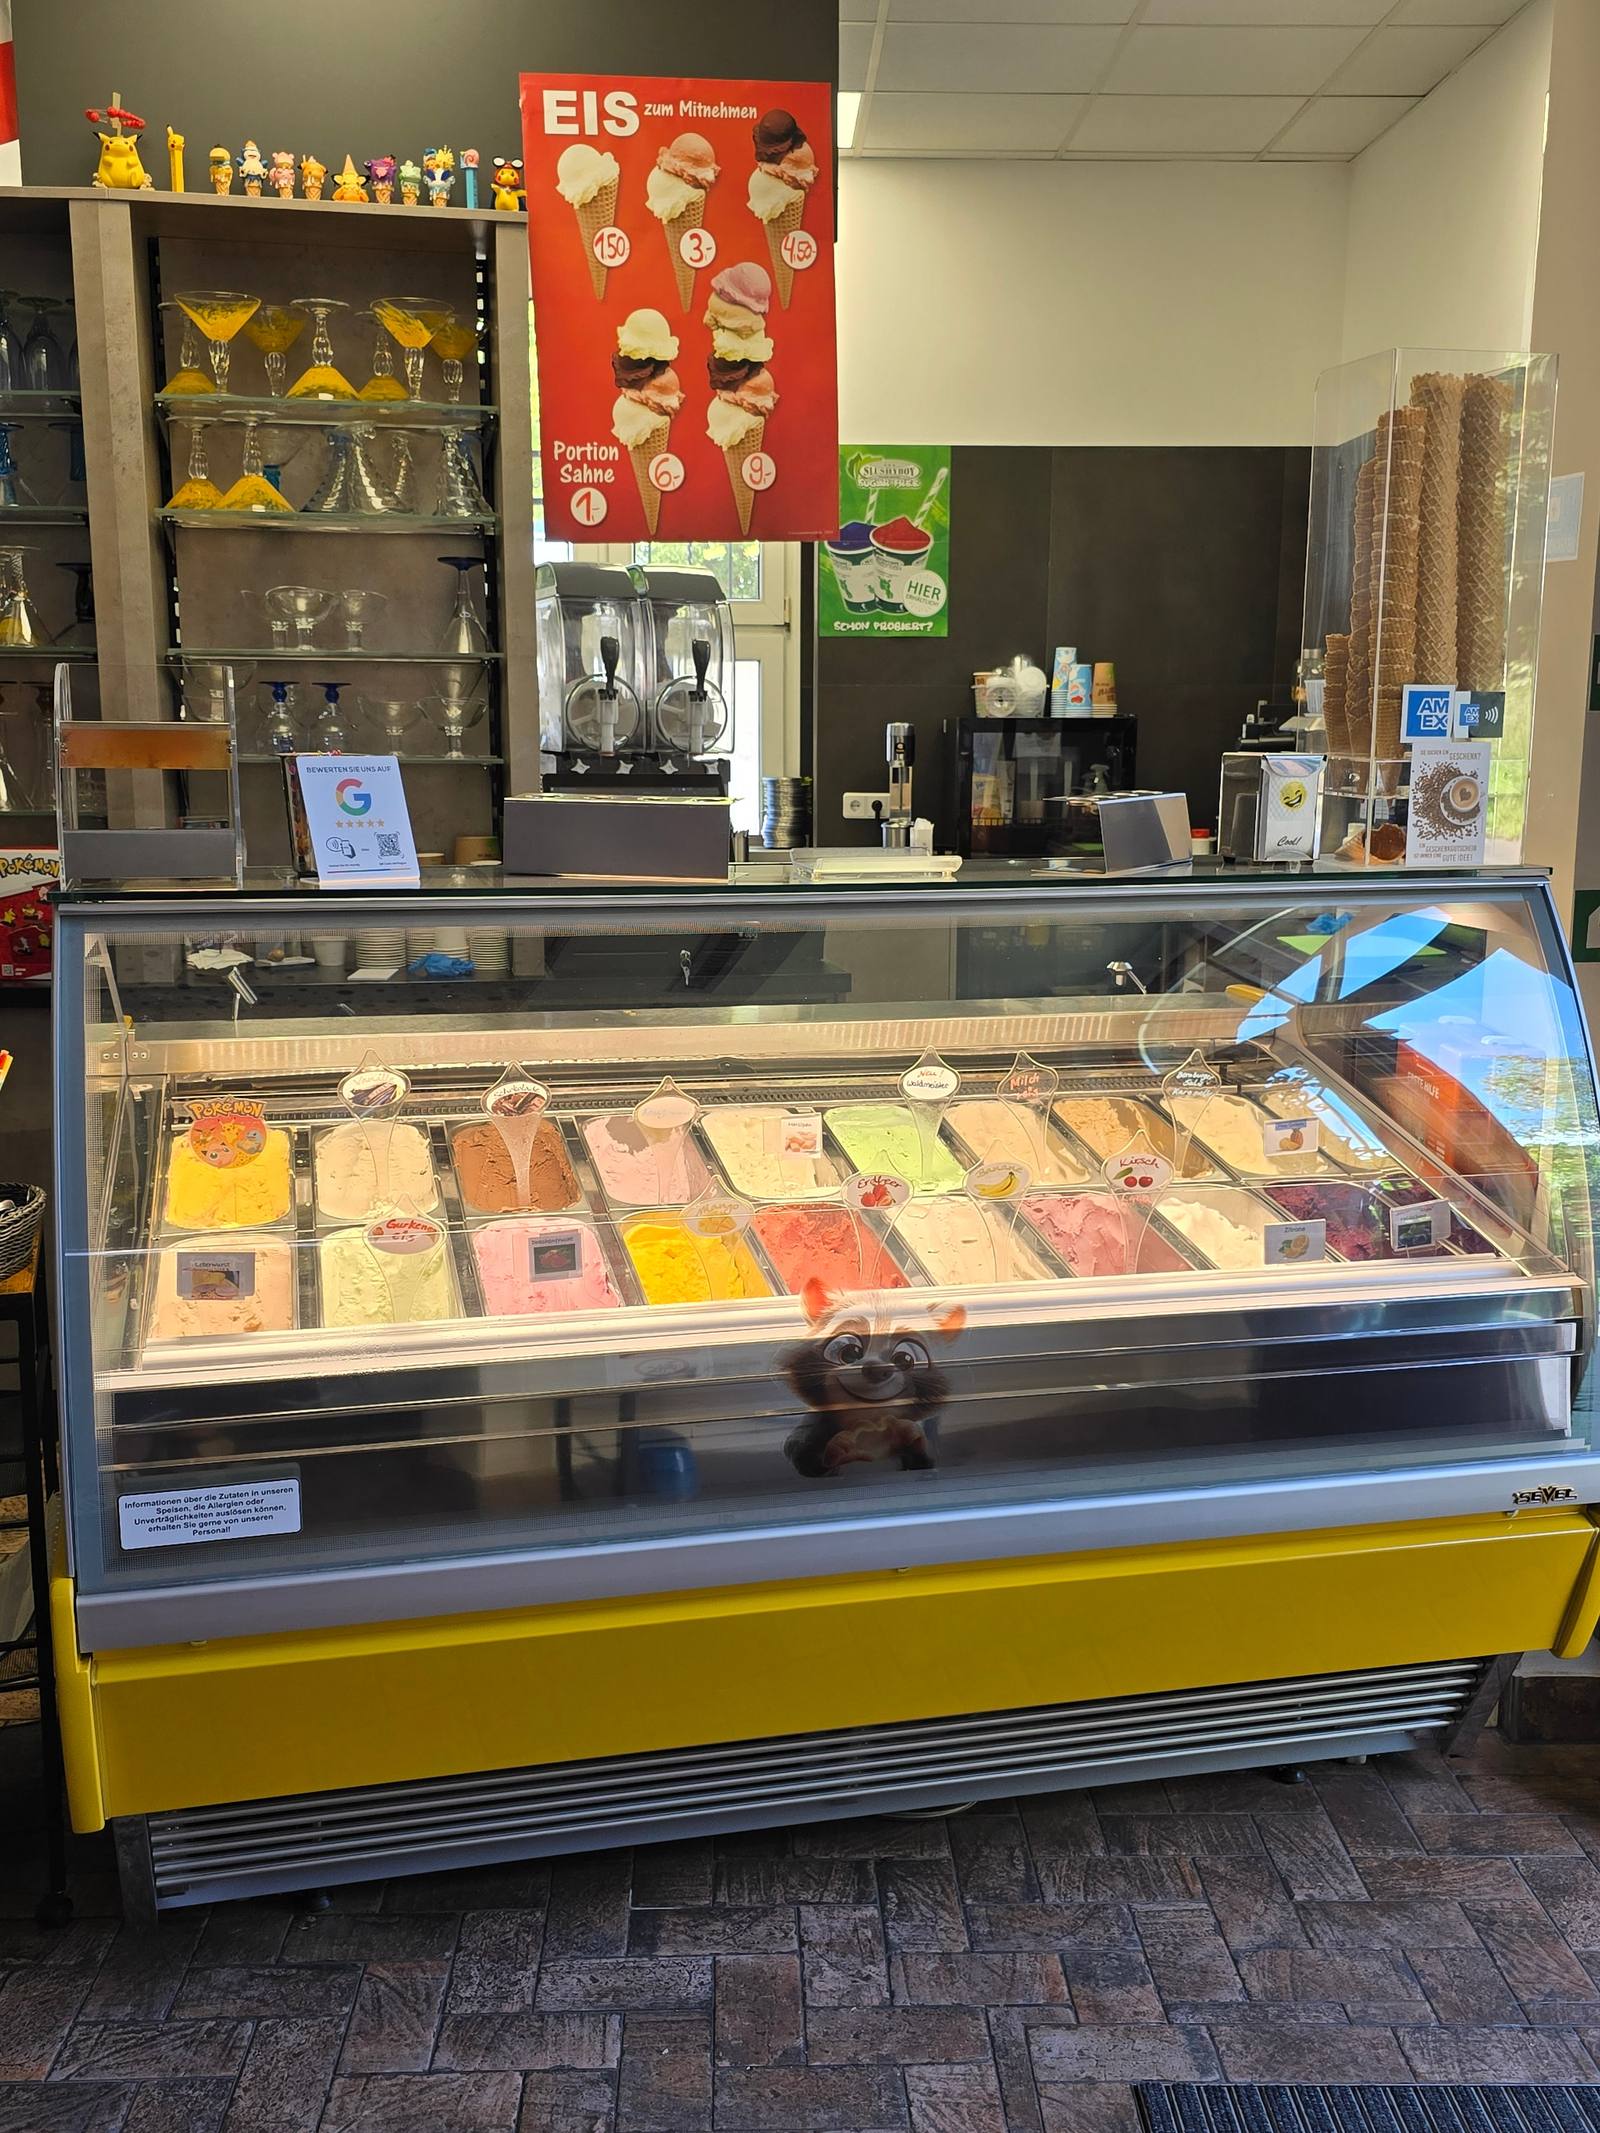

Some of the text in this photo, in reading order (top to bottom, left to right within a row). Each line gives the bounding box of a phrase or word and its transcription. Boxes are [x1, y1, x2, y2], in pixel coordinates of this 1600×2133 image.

[543, 89, 758, 137] EIS zum Mitnehmen
[553, 440, 619, 462] Portion
[560, 464, 615, 483] Sahne
[908, 580, 941, 601] HIER
[834, 621, 934, 632] SCHON PROBIERT?
[1417, 697, 1450, 714] AM
[906, 1080, 949, 1089] Waldmeister
[1010, 1072, 1040, 1090] Milch
[1120, 1156, 1159, 1168] Kirsch
[857, 1176, 902, 1188] Erdbeer
[124, 1487, 294, 1509] Informationen über die Zutaten in unseren
[1519, 1485, 1578, 1504] SEVEL
[134, 1504, 287, 1526] Unverträglichkeiten auslösen können,
[156, 1497, 264, 1515] Speisen, die Allergien oder
[148, 1514, 274, 1533] erhalten Sie gerne von unseren
[192, 1526, 231, 1537] Personal!
